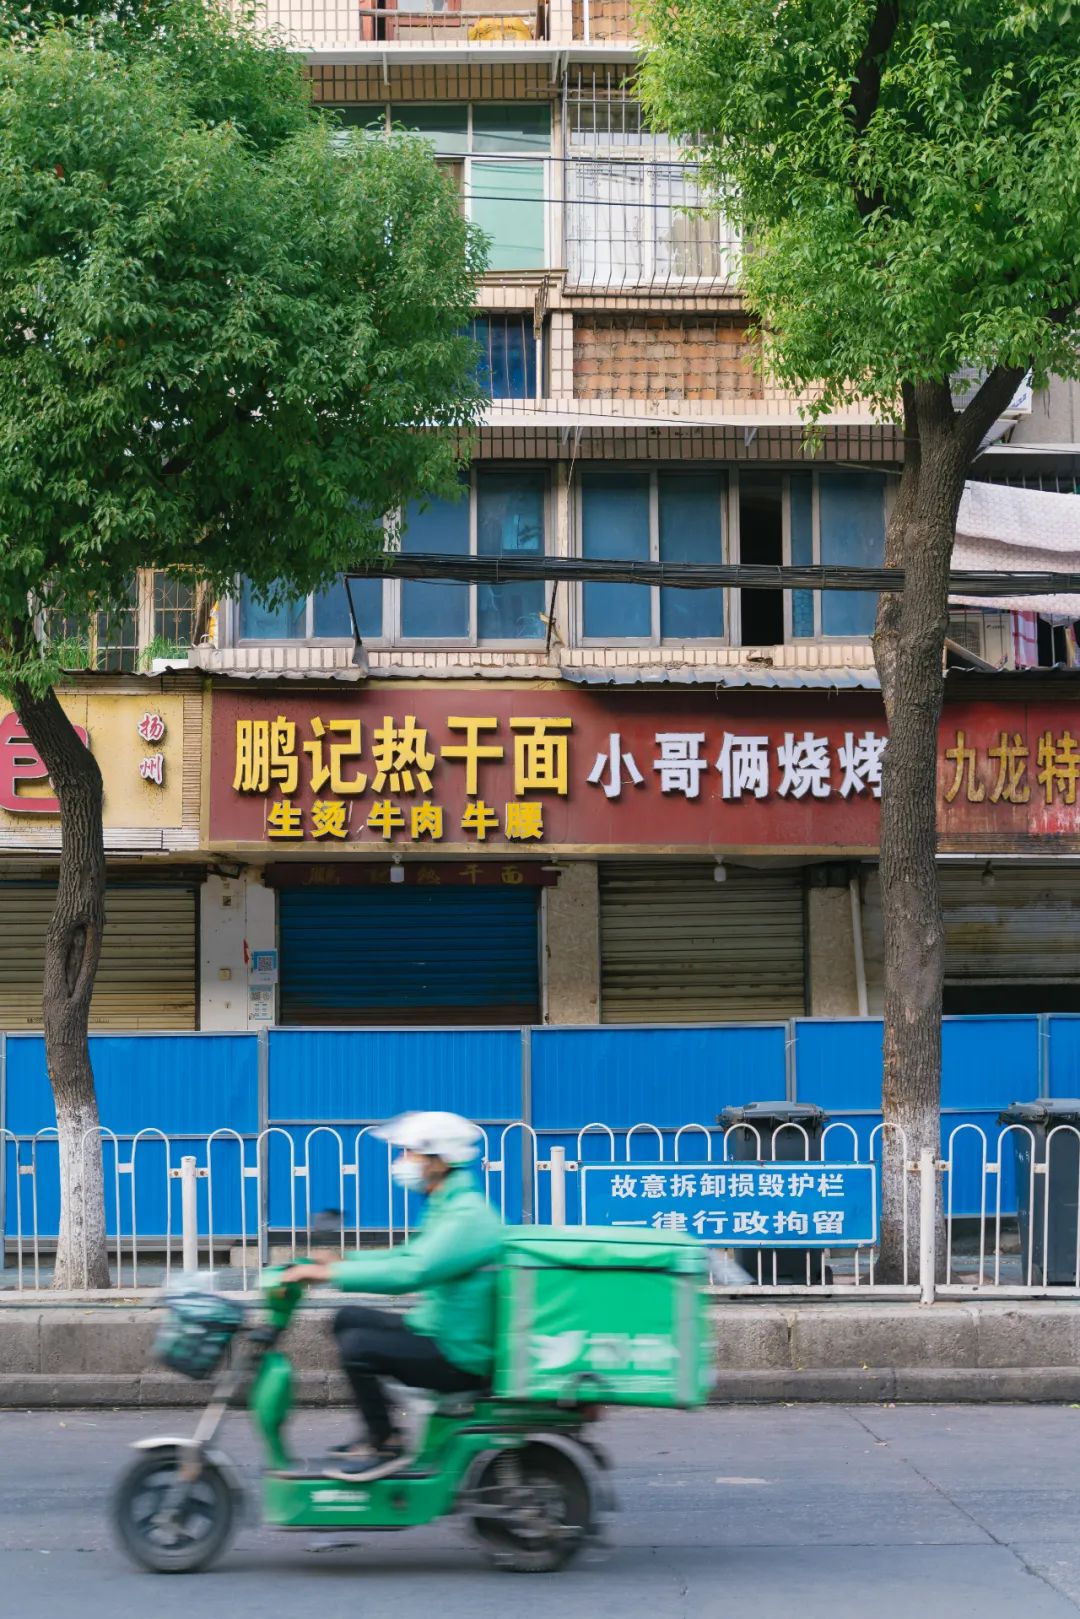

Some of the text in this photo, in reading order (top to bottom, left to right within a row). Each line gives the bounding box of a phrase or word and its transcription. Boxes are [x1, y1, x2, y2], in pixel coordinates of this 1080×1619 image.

[138, 712, 165, 785] 扬州
[232, 715, 572, 795] 鹏记热干面
[586, 731, 889, 799] 小哥俩烧烤
[944, 731, 1080, 804] 九龙特
[267, 800, 349, 838] 生烫
[367, 800, 443, 839] 牛肉
[610, 1173, 844, 1198] 故意拆卸损毁护栏
[611, 1210, 844, 1235] 一律行政拘留
